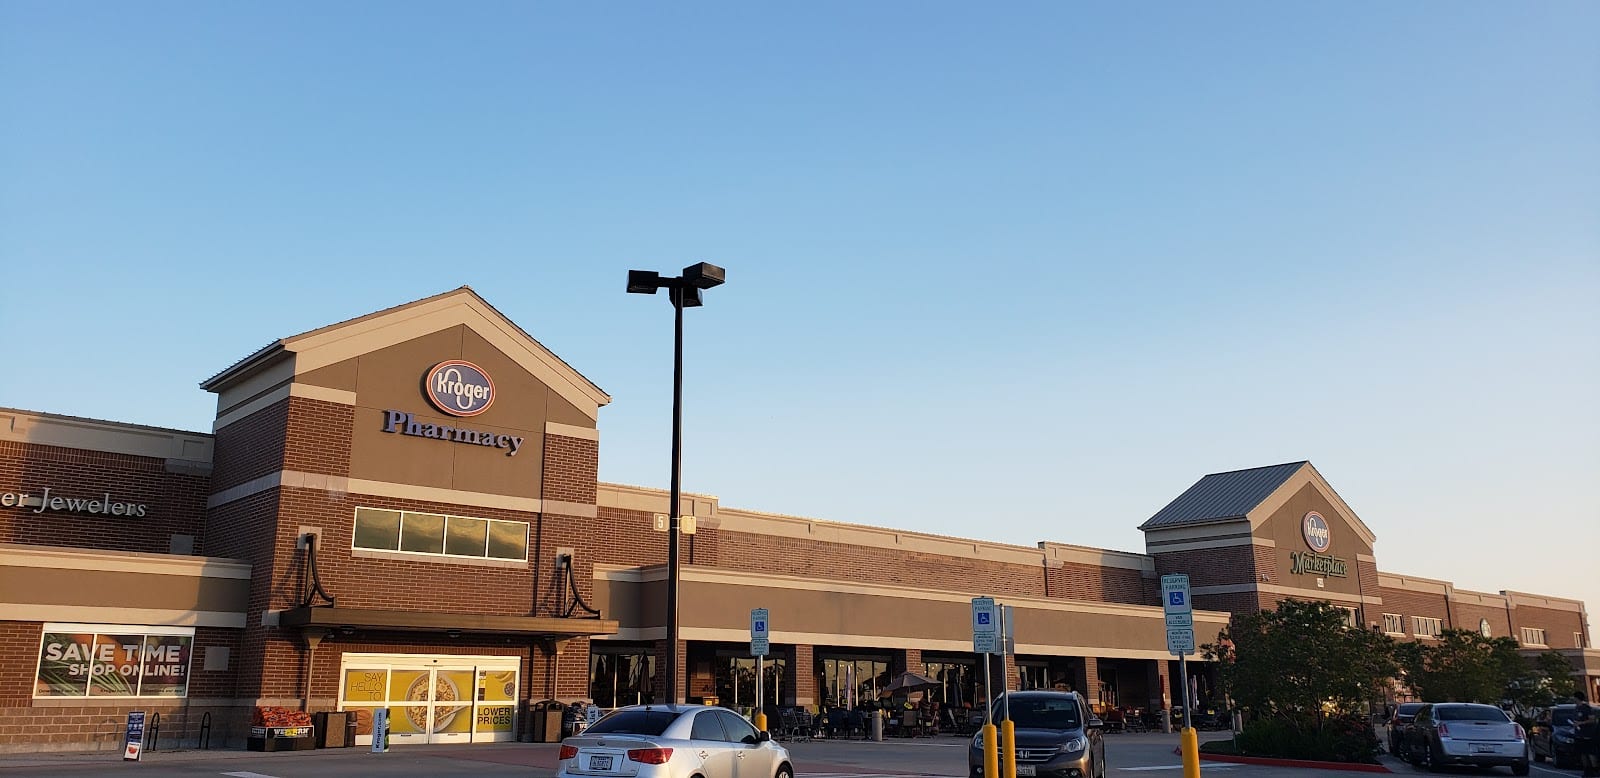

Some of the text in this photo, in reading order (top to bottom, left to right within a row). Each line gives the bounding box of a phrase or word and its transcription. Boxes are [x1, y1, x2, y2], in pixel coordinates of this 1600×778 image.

[436, 368, 490, 410] Kroger
[383, 409, 525, 456] Pharmacy
[33, 487, 146, 517] Jewelers
[657, 515, 664, 529] 5
[1307, 517, 1328, 547] Kroger
[1290, 551, 1348, 578] Marketplace
[45, 643, 182, 662] SAVE TIME
[69, 663, 186, 677] SHOP ONLINE!
[364, 672, 384, 682] SAY
[351, 682, 383, 691] HELLO
[369, 691, 382, 700] TO
[477, 707, 511, 716] LOWER
[477, 716, 511, 725] PRICES
